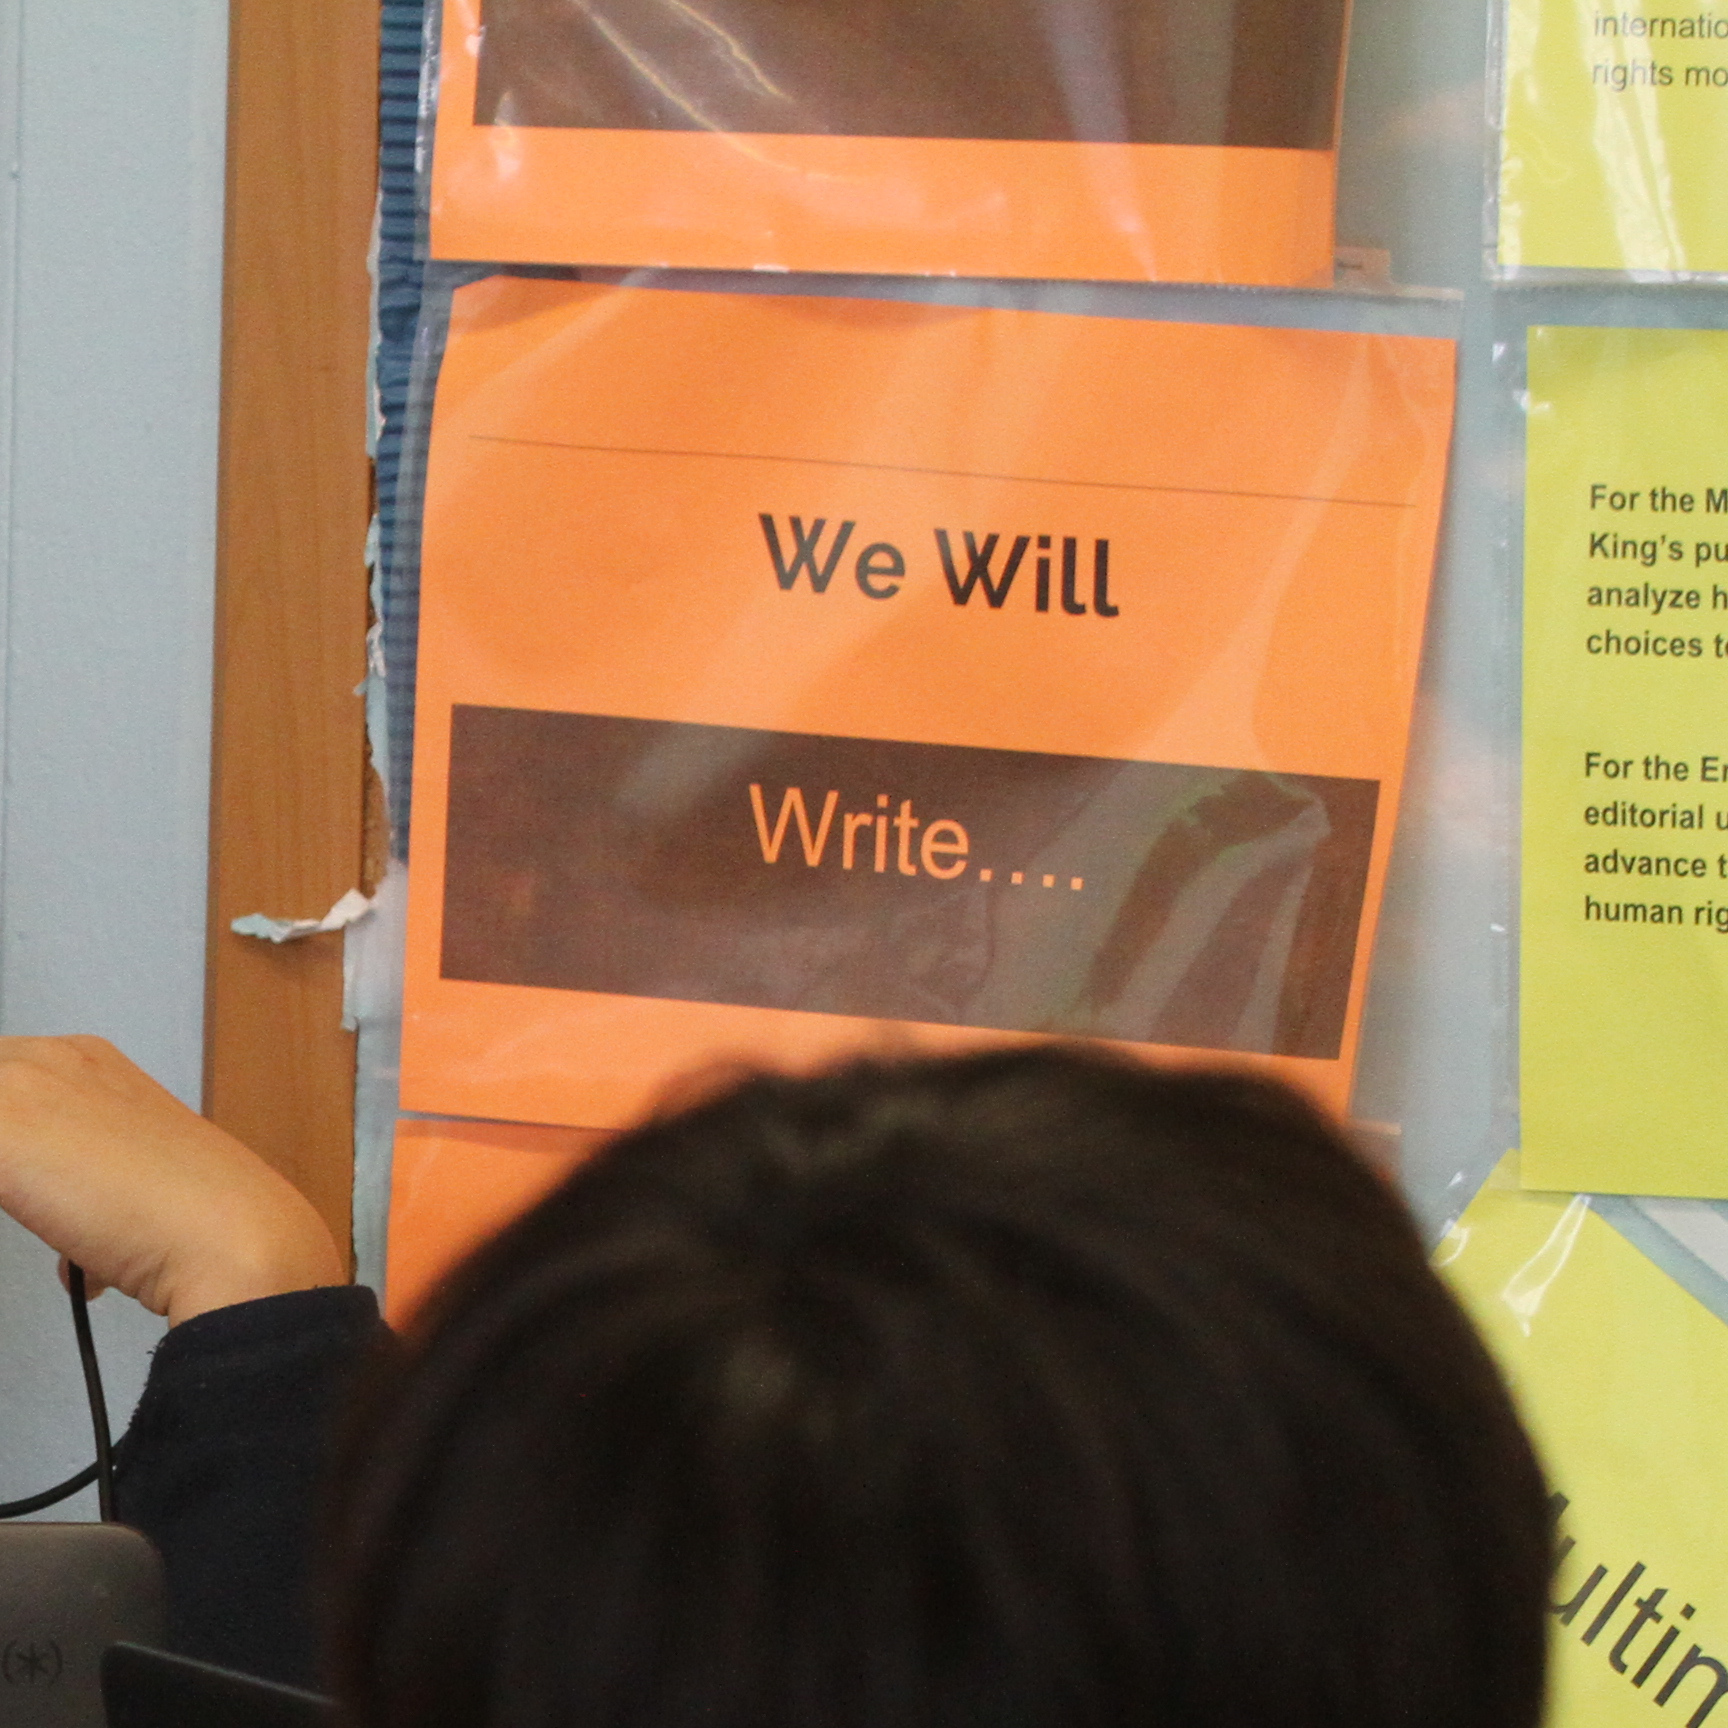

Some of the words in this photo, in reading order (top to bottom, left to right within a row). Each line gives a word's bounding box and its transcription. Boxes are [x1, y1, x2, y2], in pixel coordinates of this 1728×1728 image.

[1593, 59, 1674, 91] rights
[1590, 484, 1641, 511] For
[1649, 486, 1695, 513] the
[1705, 487, 1728, 514] M
[1589, 533, 1684, 567] King's
[758, 513, 906, 600] We
[933, 527, 1120, 618] Will
[1587, 582, 1701, 615] analyze
[1586, 629, 1703, 658] choices
[1585, 752, 1634, 779] For
[1643, 755, 1689, 782] the
[1584, 801, 1704, 829] editorial
[749, 783, 1084, 891] Write....
[1584, 848, 1707, 878] advance
[1585, 895, 1683, 924] human
